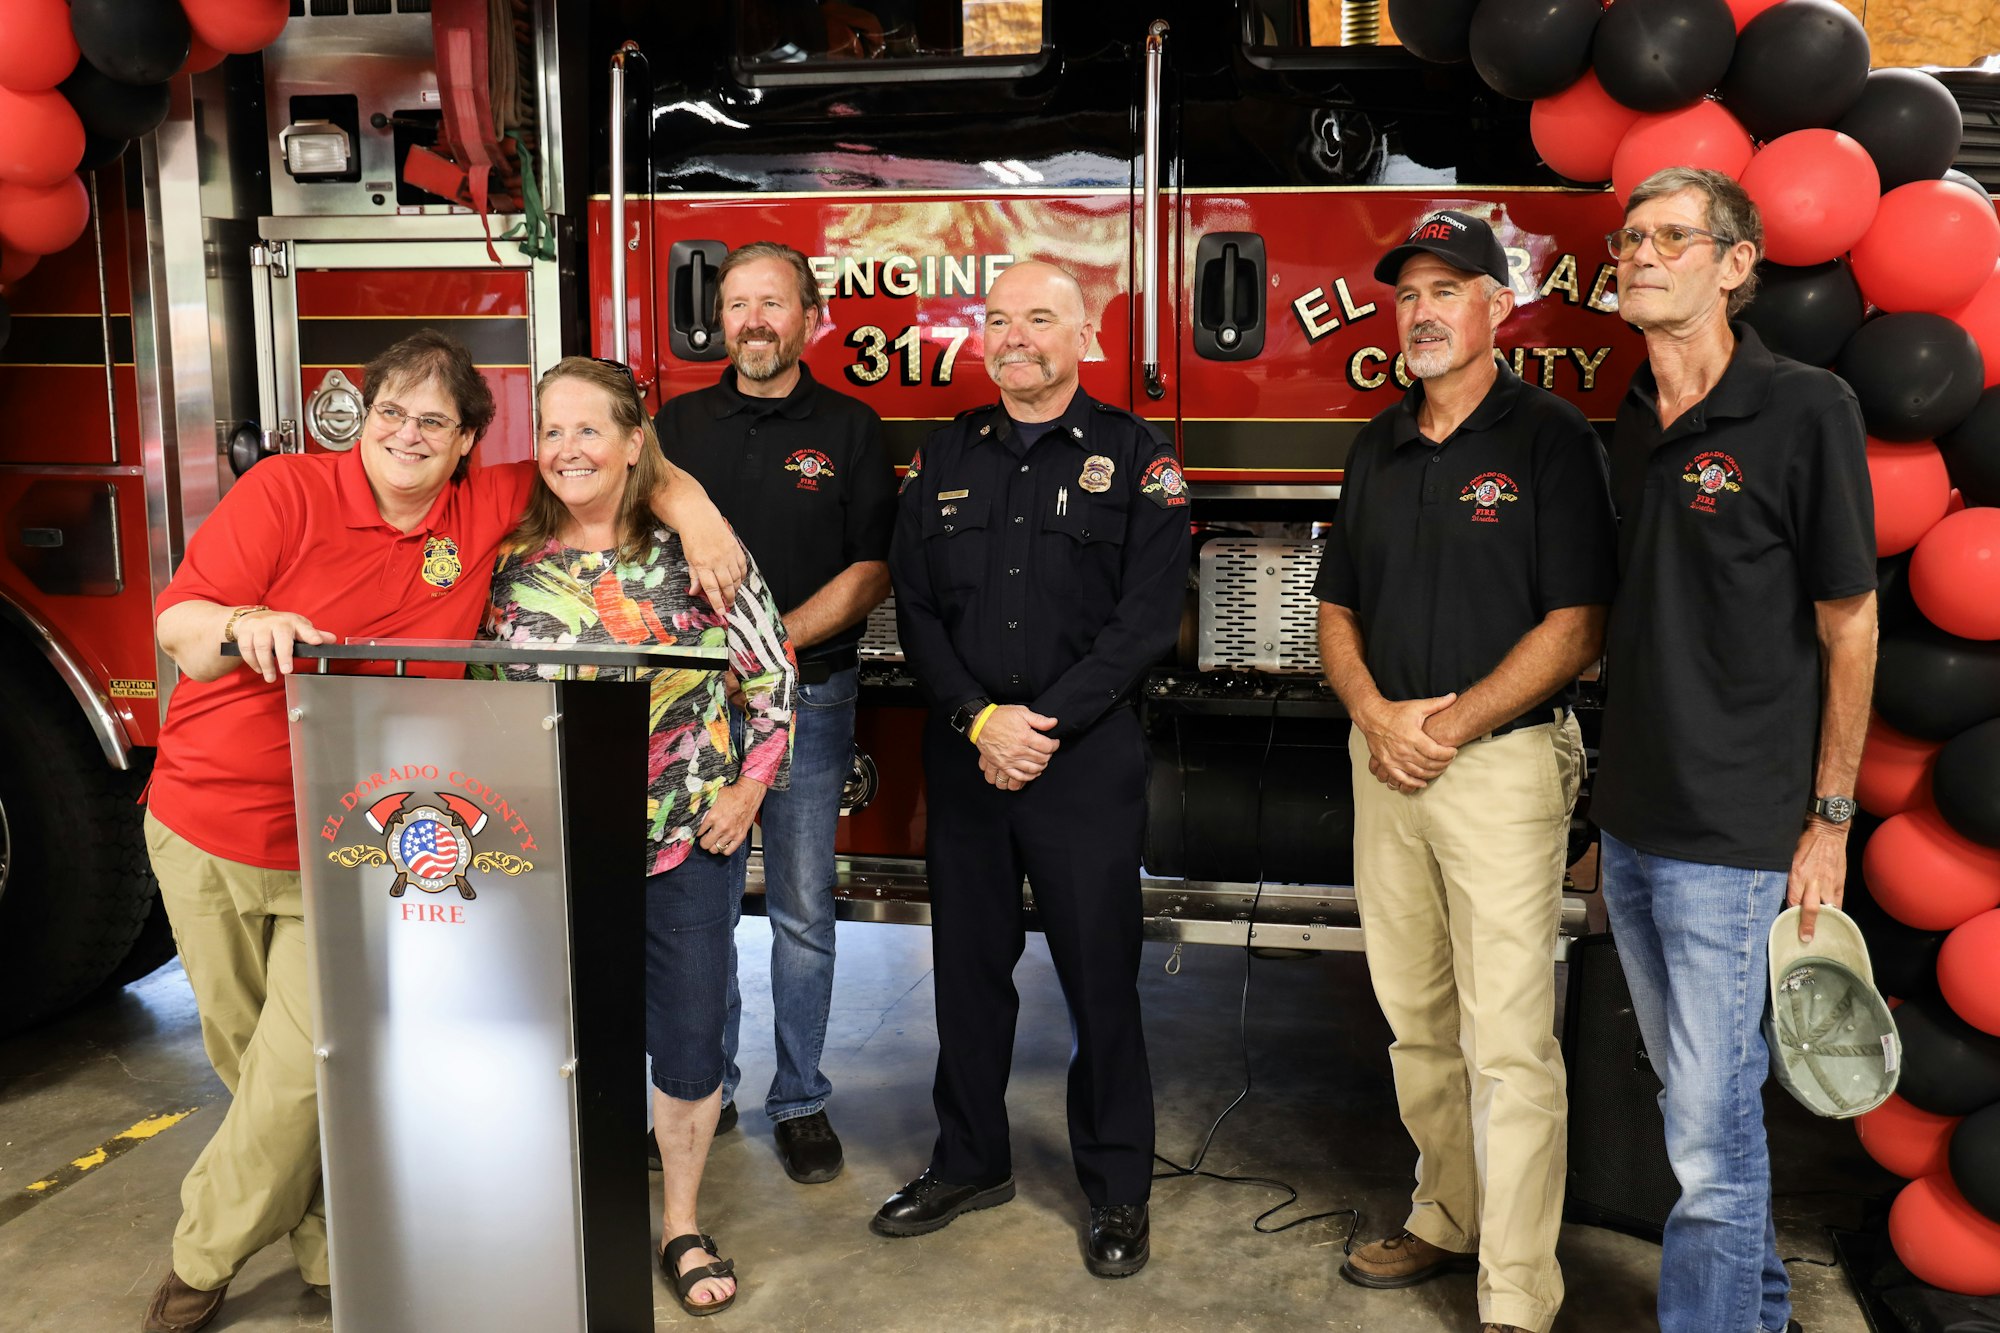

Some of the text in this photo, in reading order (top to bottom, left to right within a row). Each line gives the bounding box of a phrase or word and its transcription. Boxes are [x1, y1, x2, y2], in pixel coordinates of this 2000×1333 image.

[1440, 214, 1468, 232] COUNTY
[1292, 277, 1377, 342] EL
[848, 325, 969, 384] 317
[1694, 451, 1725, 462] DORADO
[1725, 455, 1744, 482] COUNTY
[800, 477, 817, 485] FIRE
[1470, 472, 1497, 486] DORADO
[1497, 473, 1519, 493] COUNTY
[1167, 497, 1185, 506] FIRE
[1696, 494, 1716, 505] FIRE
[1475, 508, 1496, 516] FIRE
[112, 681, 153, 689] CAUTION
[113, 688, 125, 696] Hot
[321, 764, 538, 853] EL DORADO COUNTY
[417, 810, 440, 821] Est.
[392, 833, 401, 860] FIRE
[457, 838, 467, 865] EMS
[420, 879, 444, 889] 1991
[401, 903, 466, 924] FIRE
